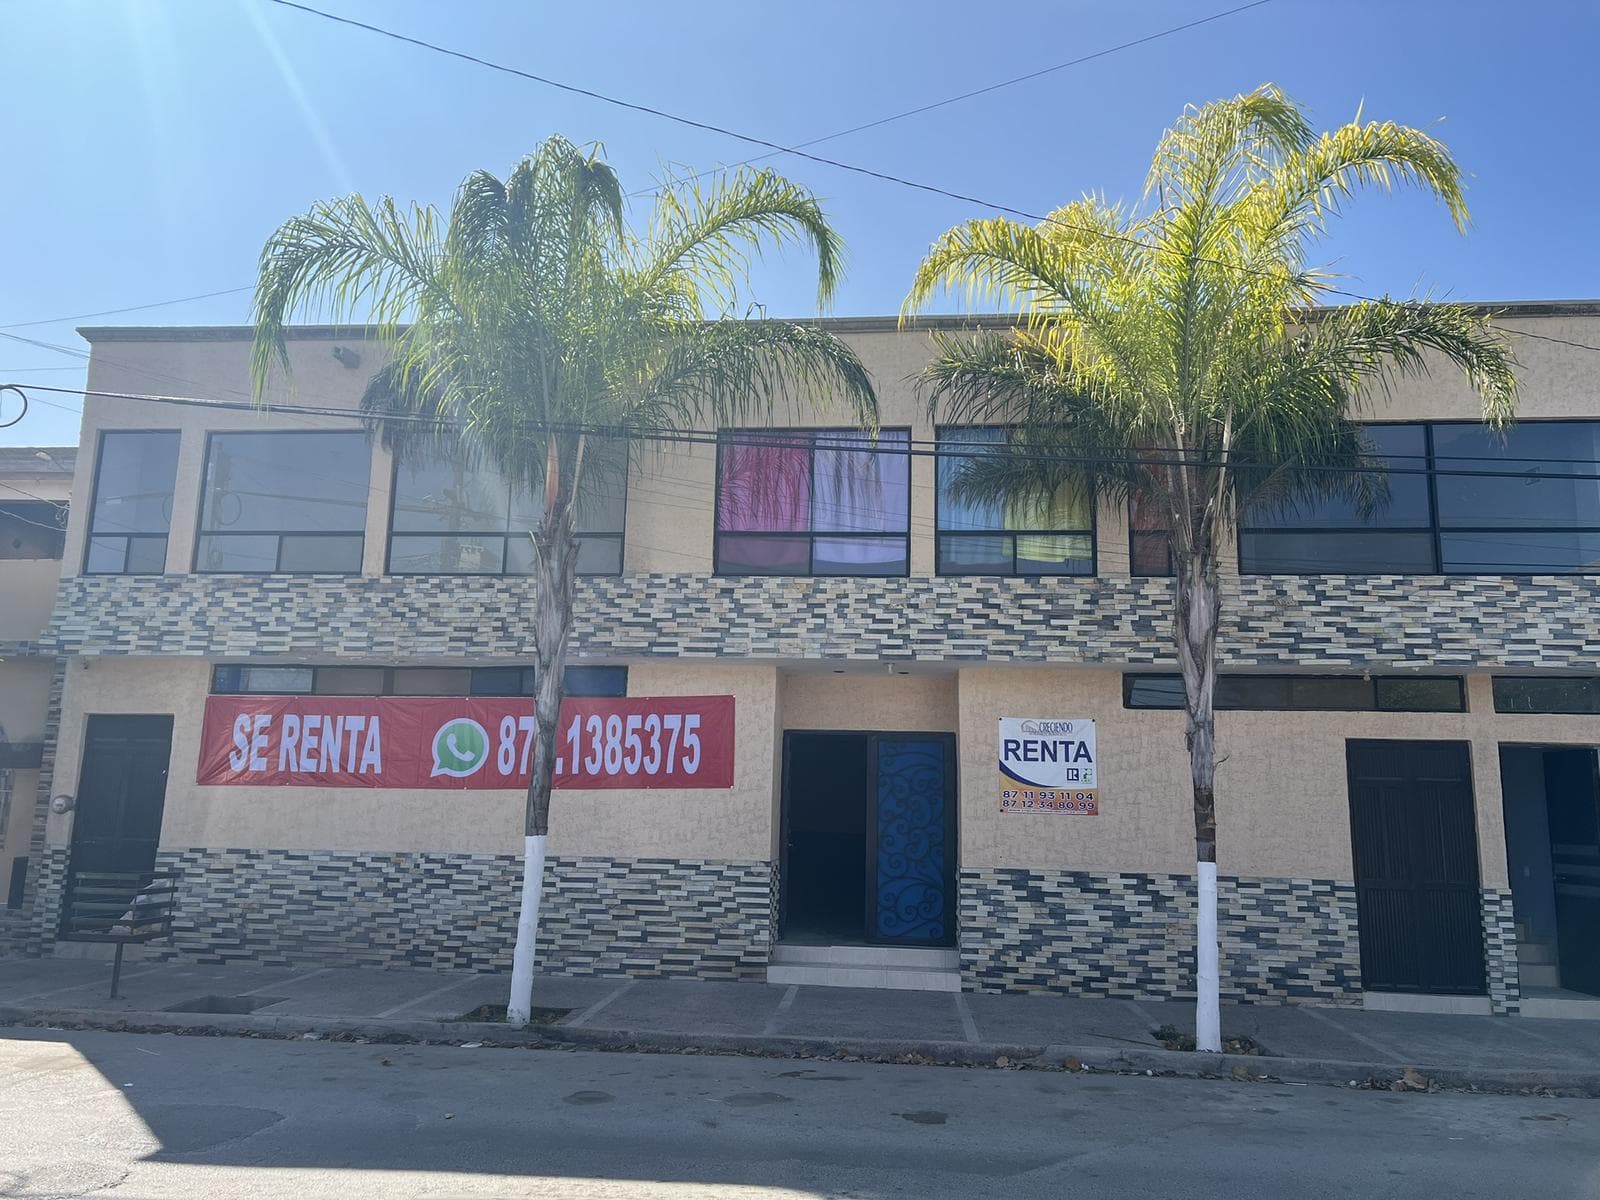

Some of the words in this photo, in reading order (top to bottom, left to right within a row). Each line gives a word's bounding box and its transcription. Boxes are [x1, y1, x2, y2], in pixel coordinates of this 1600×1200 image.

[1038, 721, 1073, 733] CRECIENDO
[229, 713, 273, 773] SE
[278, 713, 382, 775] RENTA
[497, 713, 701, 776] 87.1385375
[1003, 739, 1093, 763] RENTA
[1002, 790, 1018, 799] 87
[1023, 791, 1034, 799] 11
[1039, 791, 1055, 800] 93
[1060, 792, 1071, 800] 11
[1076, 792, 1093, 801] 04
[1002, 800, 1017, 808] 87
[1021, 800, 1034, 808] 12
[1038, 801, 1053, 809] 34
[1058, 801, 1074, 809] 80
[1079, 802, 1095, 810] 99
